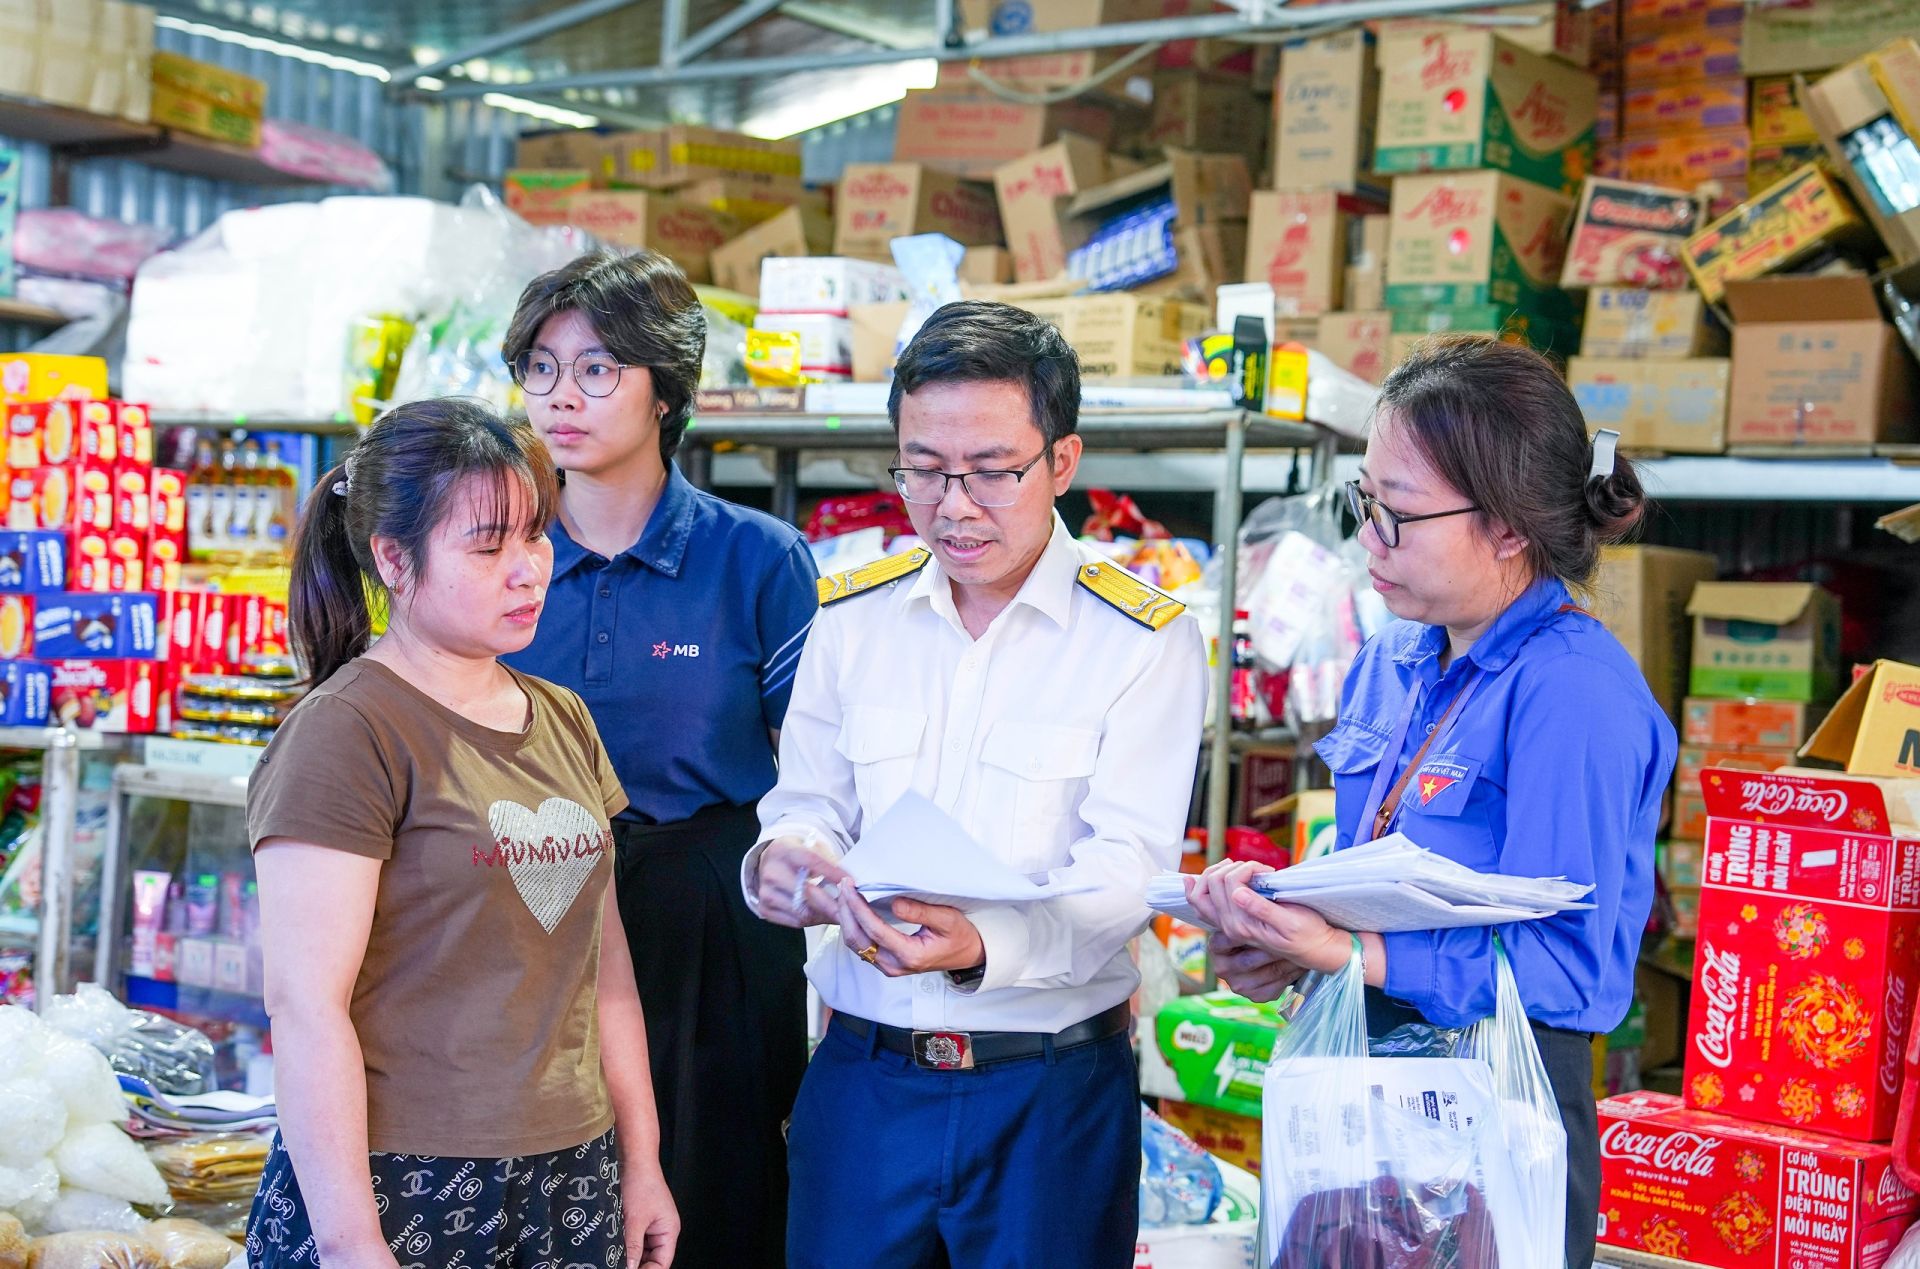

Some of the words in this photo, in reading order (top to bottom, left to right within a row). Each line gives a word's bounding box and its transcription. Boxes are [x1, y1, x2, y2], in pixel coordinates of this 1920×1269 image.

[673, 644, 700, 658] MB
[1740, 780, 1848, 822] Coca-Cola
[1724, 825, 1752, 884] TRÚNG
[1696, 940, 1740, 1068] Coca-Cola
[1600, 1121, 1723, 1176] Coca-Cola
[1787, 1150, 1800, 1164] CƠ
[1800, 1152, 1818, 1171] HỘI
[432, 1161, 476, 1202] CHANEL
[1786, 1167, 1850, 1202] TRÚNG
[570, 1209, 605, 1246] CHANEL
[1785, 1194, 1811, 1214] ĐIỆN
[1812, 1199, 1848, 1222] THOẠI
[388, 1213, 424, 1254] CHANE
[1784, 1214, 1810, 1237] MỖI
[1812, 1221, 1848, 1244] NGÀY
